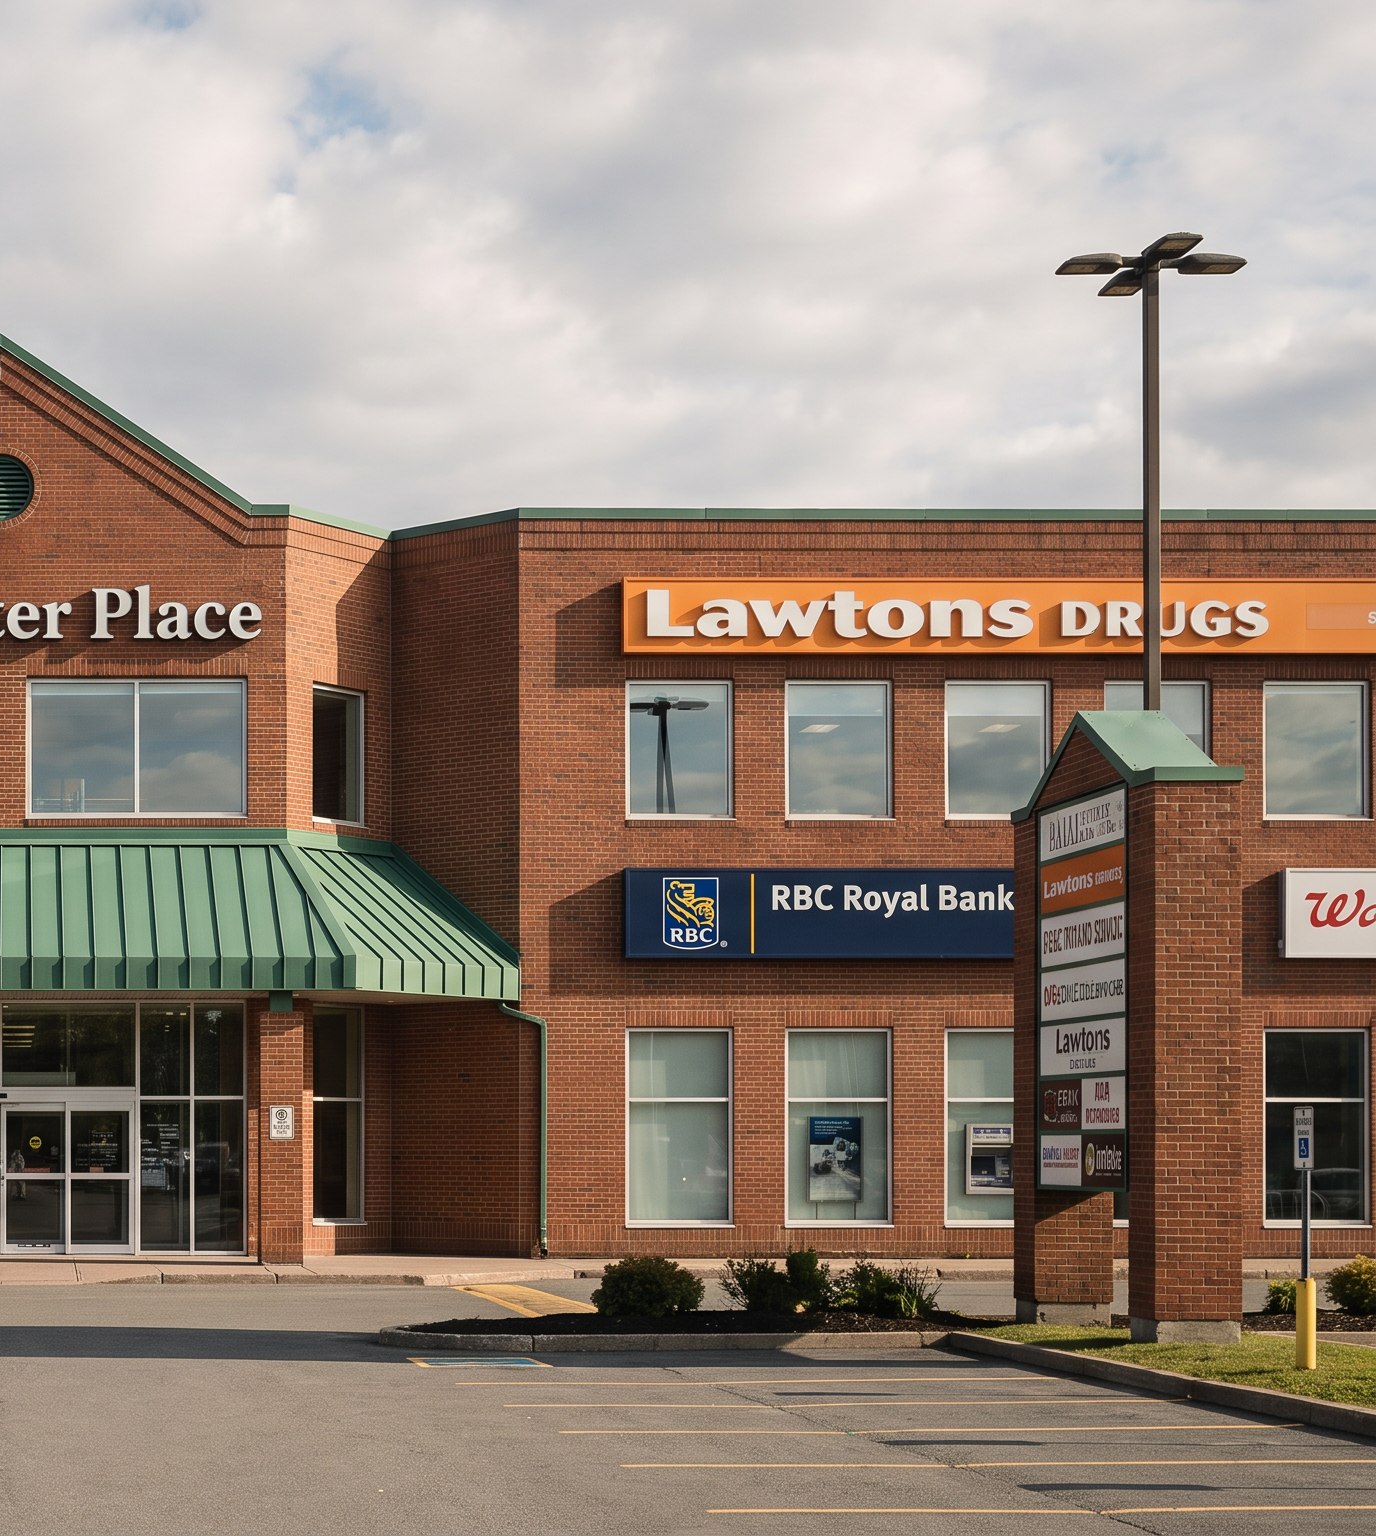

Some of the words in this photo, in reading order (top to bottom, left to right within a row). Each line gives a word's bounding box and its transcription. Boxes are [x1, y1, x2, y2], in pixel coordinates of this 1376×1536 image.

[90, 584, 263, 641] Place
[646, 589, 1034, 639] Lawtons
[1061, 600, 1270, 638] DRUGS
[771, 884, 834, 911] RBC
[843, 883, 930, 919] Royal
[939, 883, 1015, 911] Bank
[1043, 872, 1094, 899] Lawtons
[670, 928, 713, 943] RBC
[1056, 1027, 1111, 1054] Lawtons
